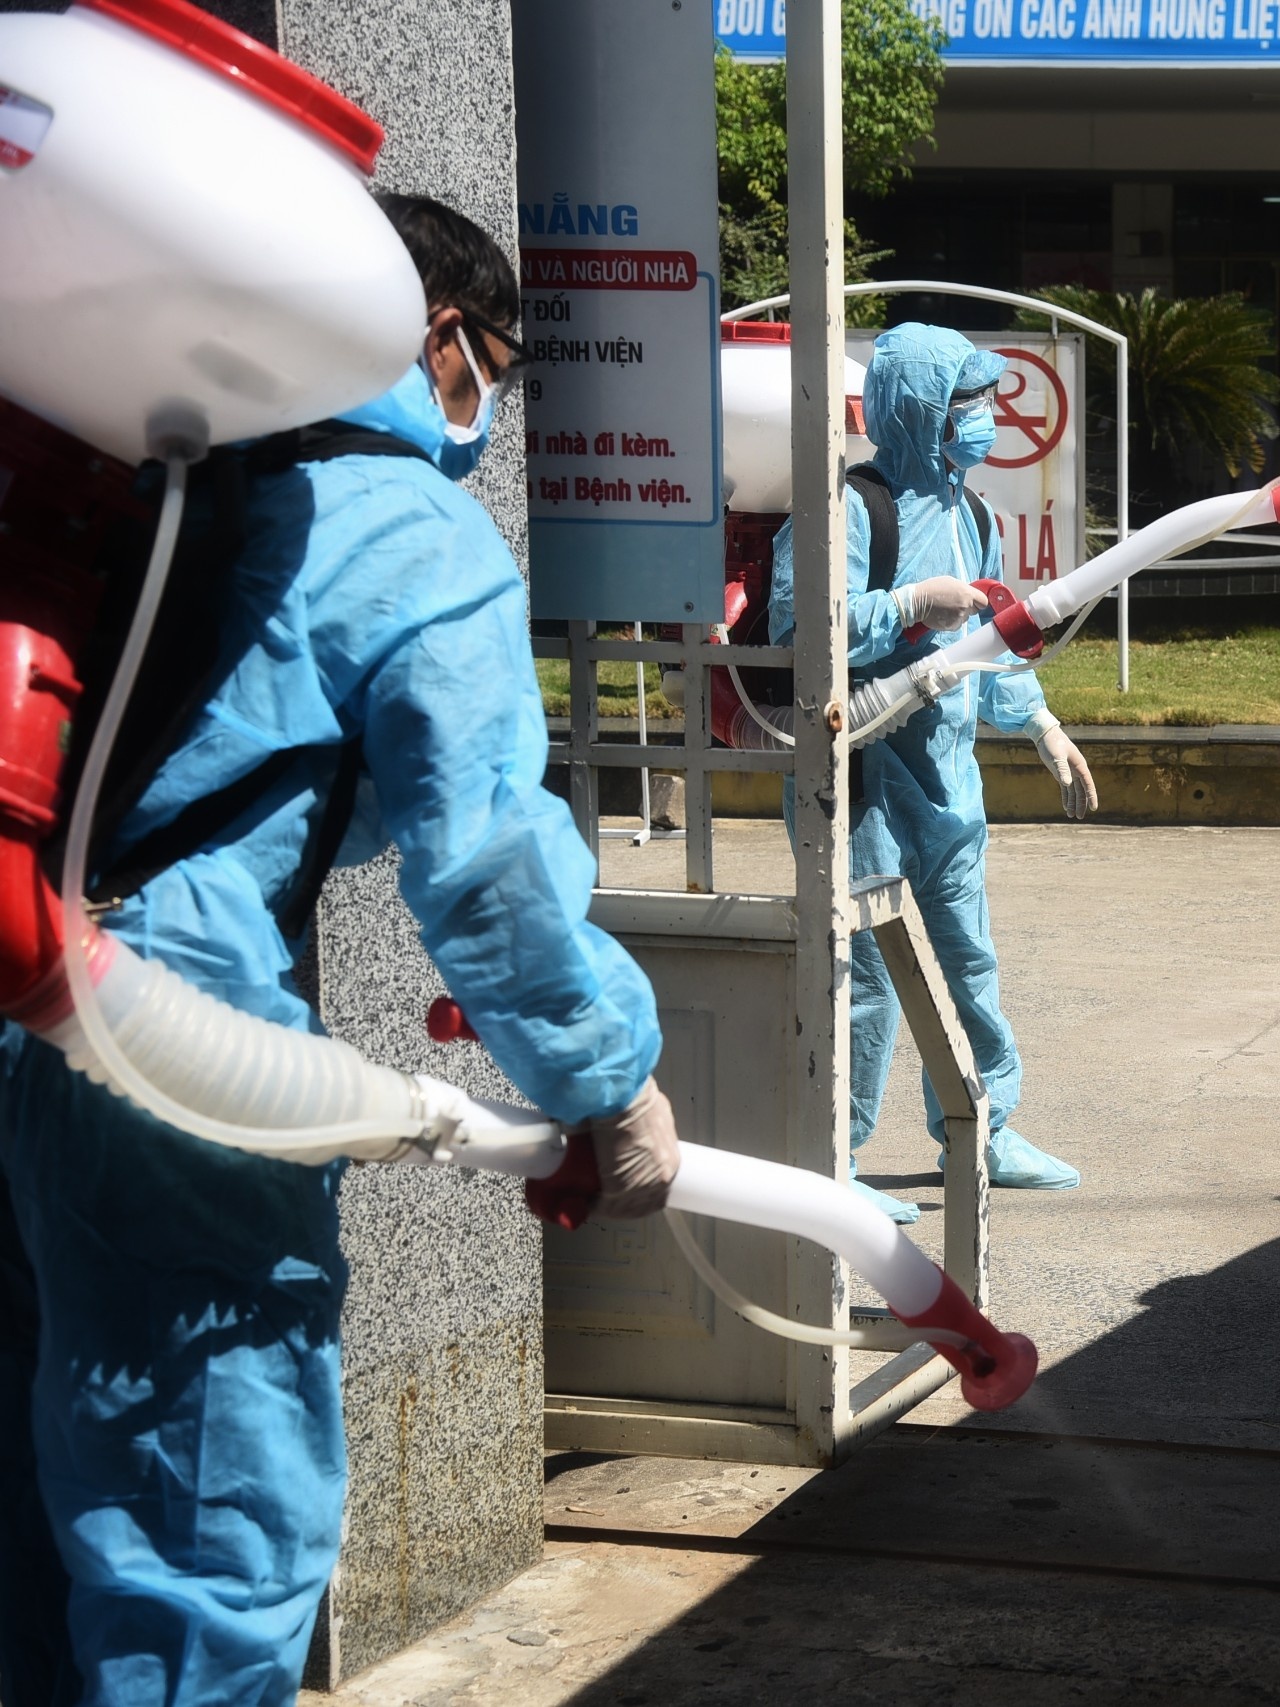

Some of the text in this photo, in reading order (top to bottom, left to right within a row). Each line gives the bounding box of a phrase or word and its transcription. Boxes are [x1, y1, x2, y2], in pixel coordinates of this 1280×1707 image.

[518, 192, 639, 236] NẴNG
[538, 256, 567, 281] VÀ
[572, 256, 638, 282] NGƯỜI
[645, 257, 689, 283] NHÀ
[533, 292, 570, 322] ĐỐI
[534, 335, 643, 368] BỆNH VIỆN
[545, 431, 587, 455] nhà
[594, 432, 615, 456] đi
[621, 433, 676, 457] kèm.
[539, 477, 568, 505] tại
[575, 477, 631, 506] Bệnh
[638, 478, 691, 508] viện.
[1019, 499, 1057, 580] LÁ
